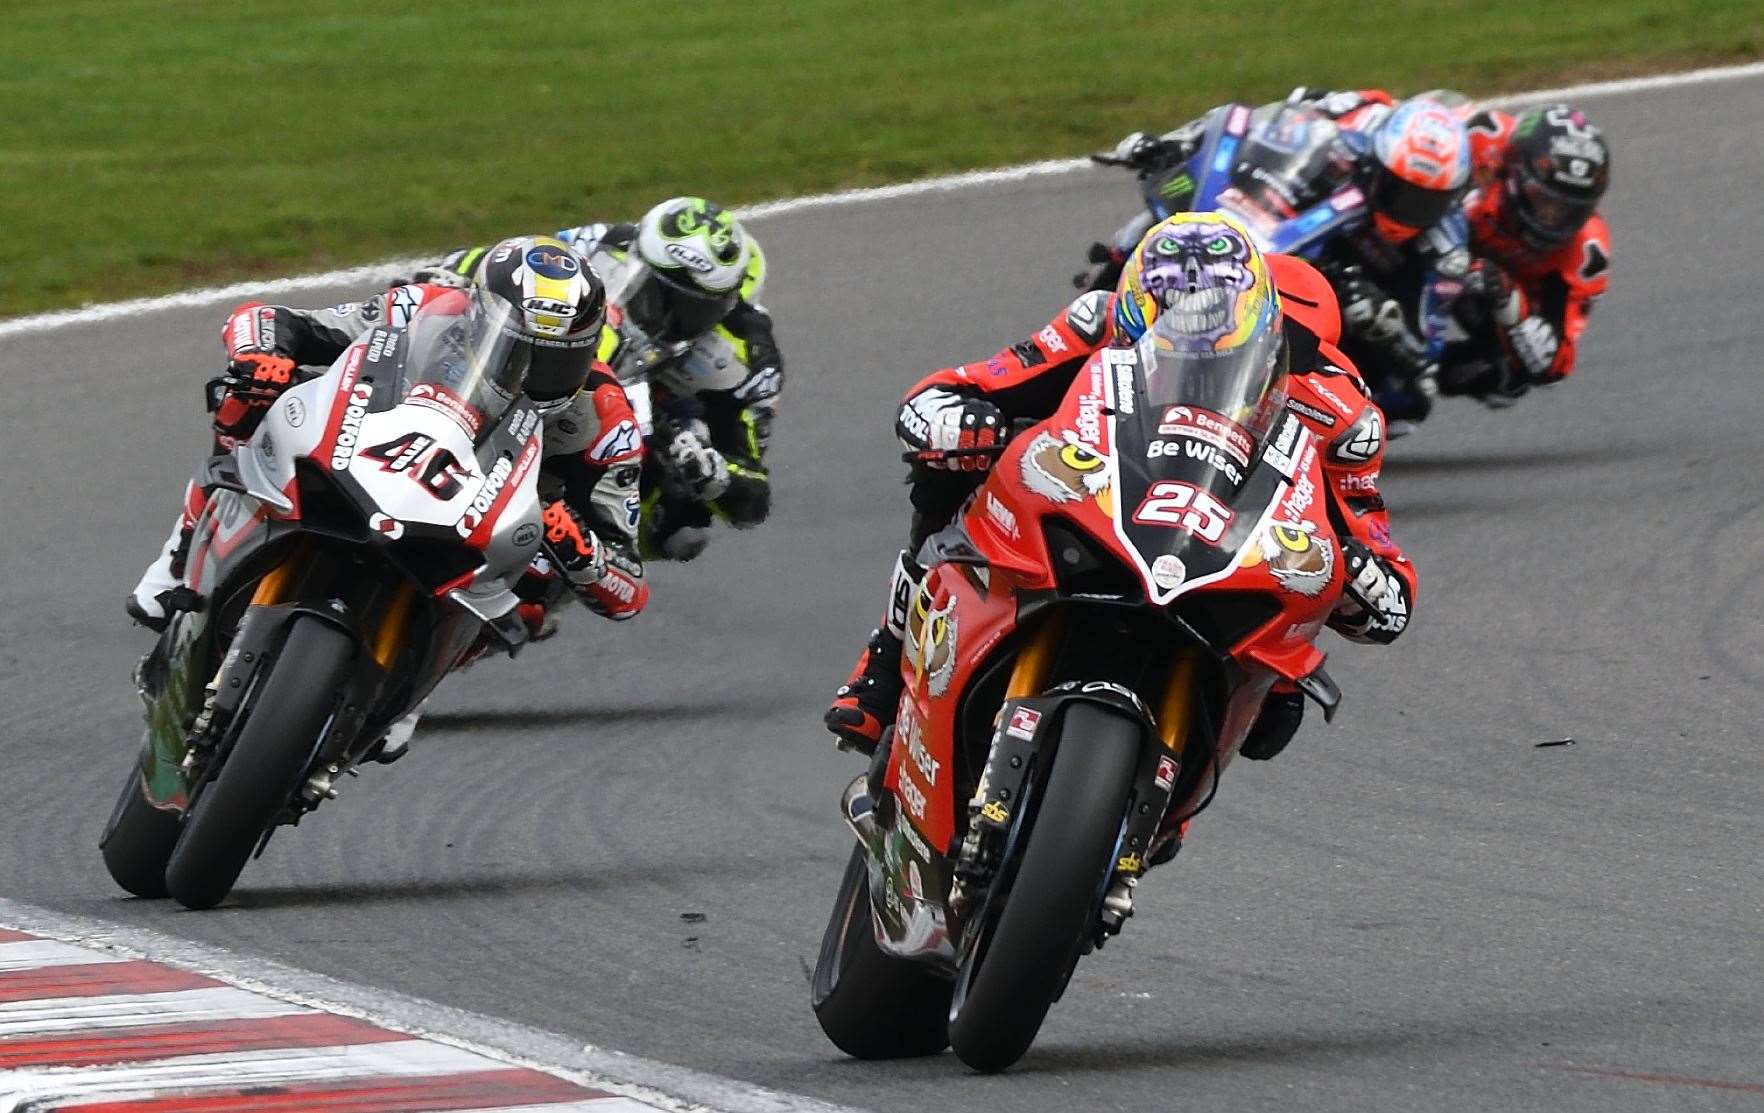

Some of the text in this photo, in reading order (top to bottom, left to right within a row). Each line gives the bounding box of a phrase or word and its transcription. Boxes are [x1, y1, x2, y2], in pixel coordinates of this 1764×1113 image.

[526, 299, 572, 315] HJC
[331, 405, 366, 471] OXFORD
[1196, 414, 1252, 452] Bennetts
[358, 432, 472, 502] 46
[473, 457, 514, 512] OXFORD
[1147, 440, 1180, 458] Be
[1185, 440, 1243, 486] Wiser
[1134, 481, 1233, 543] 25
